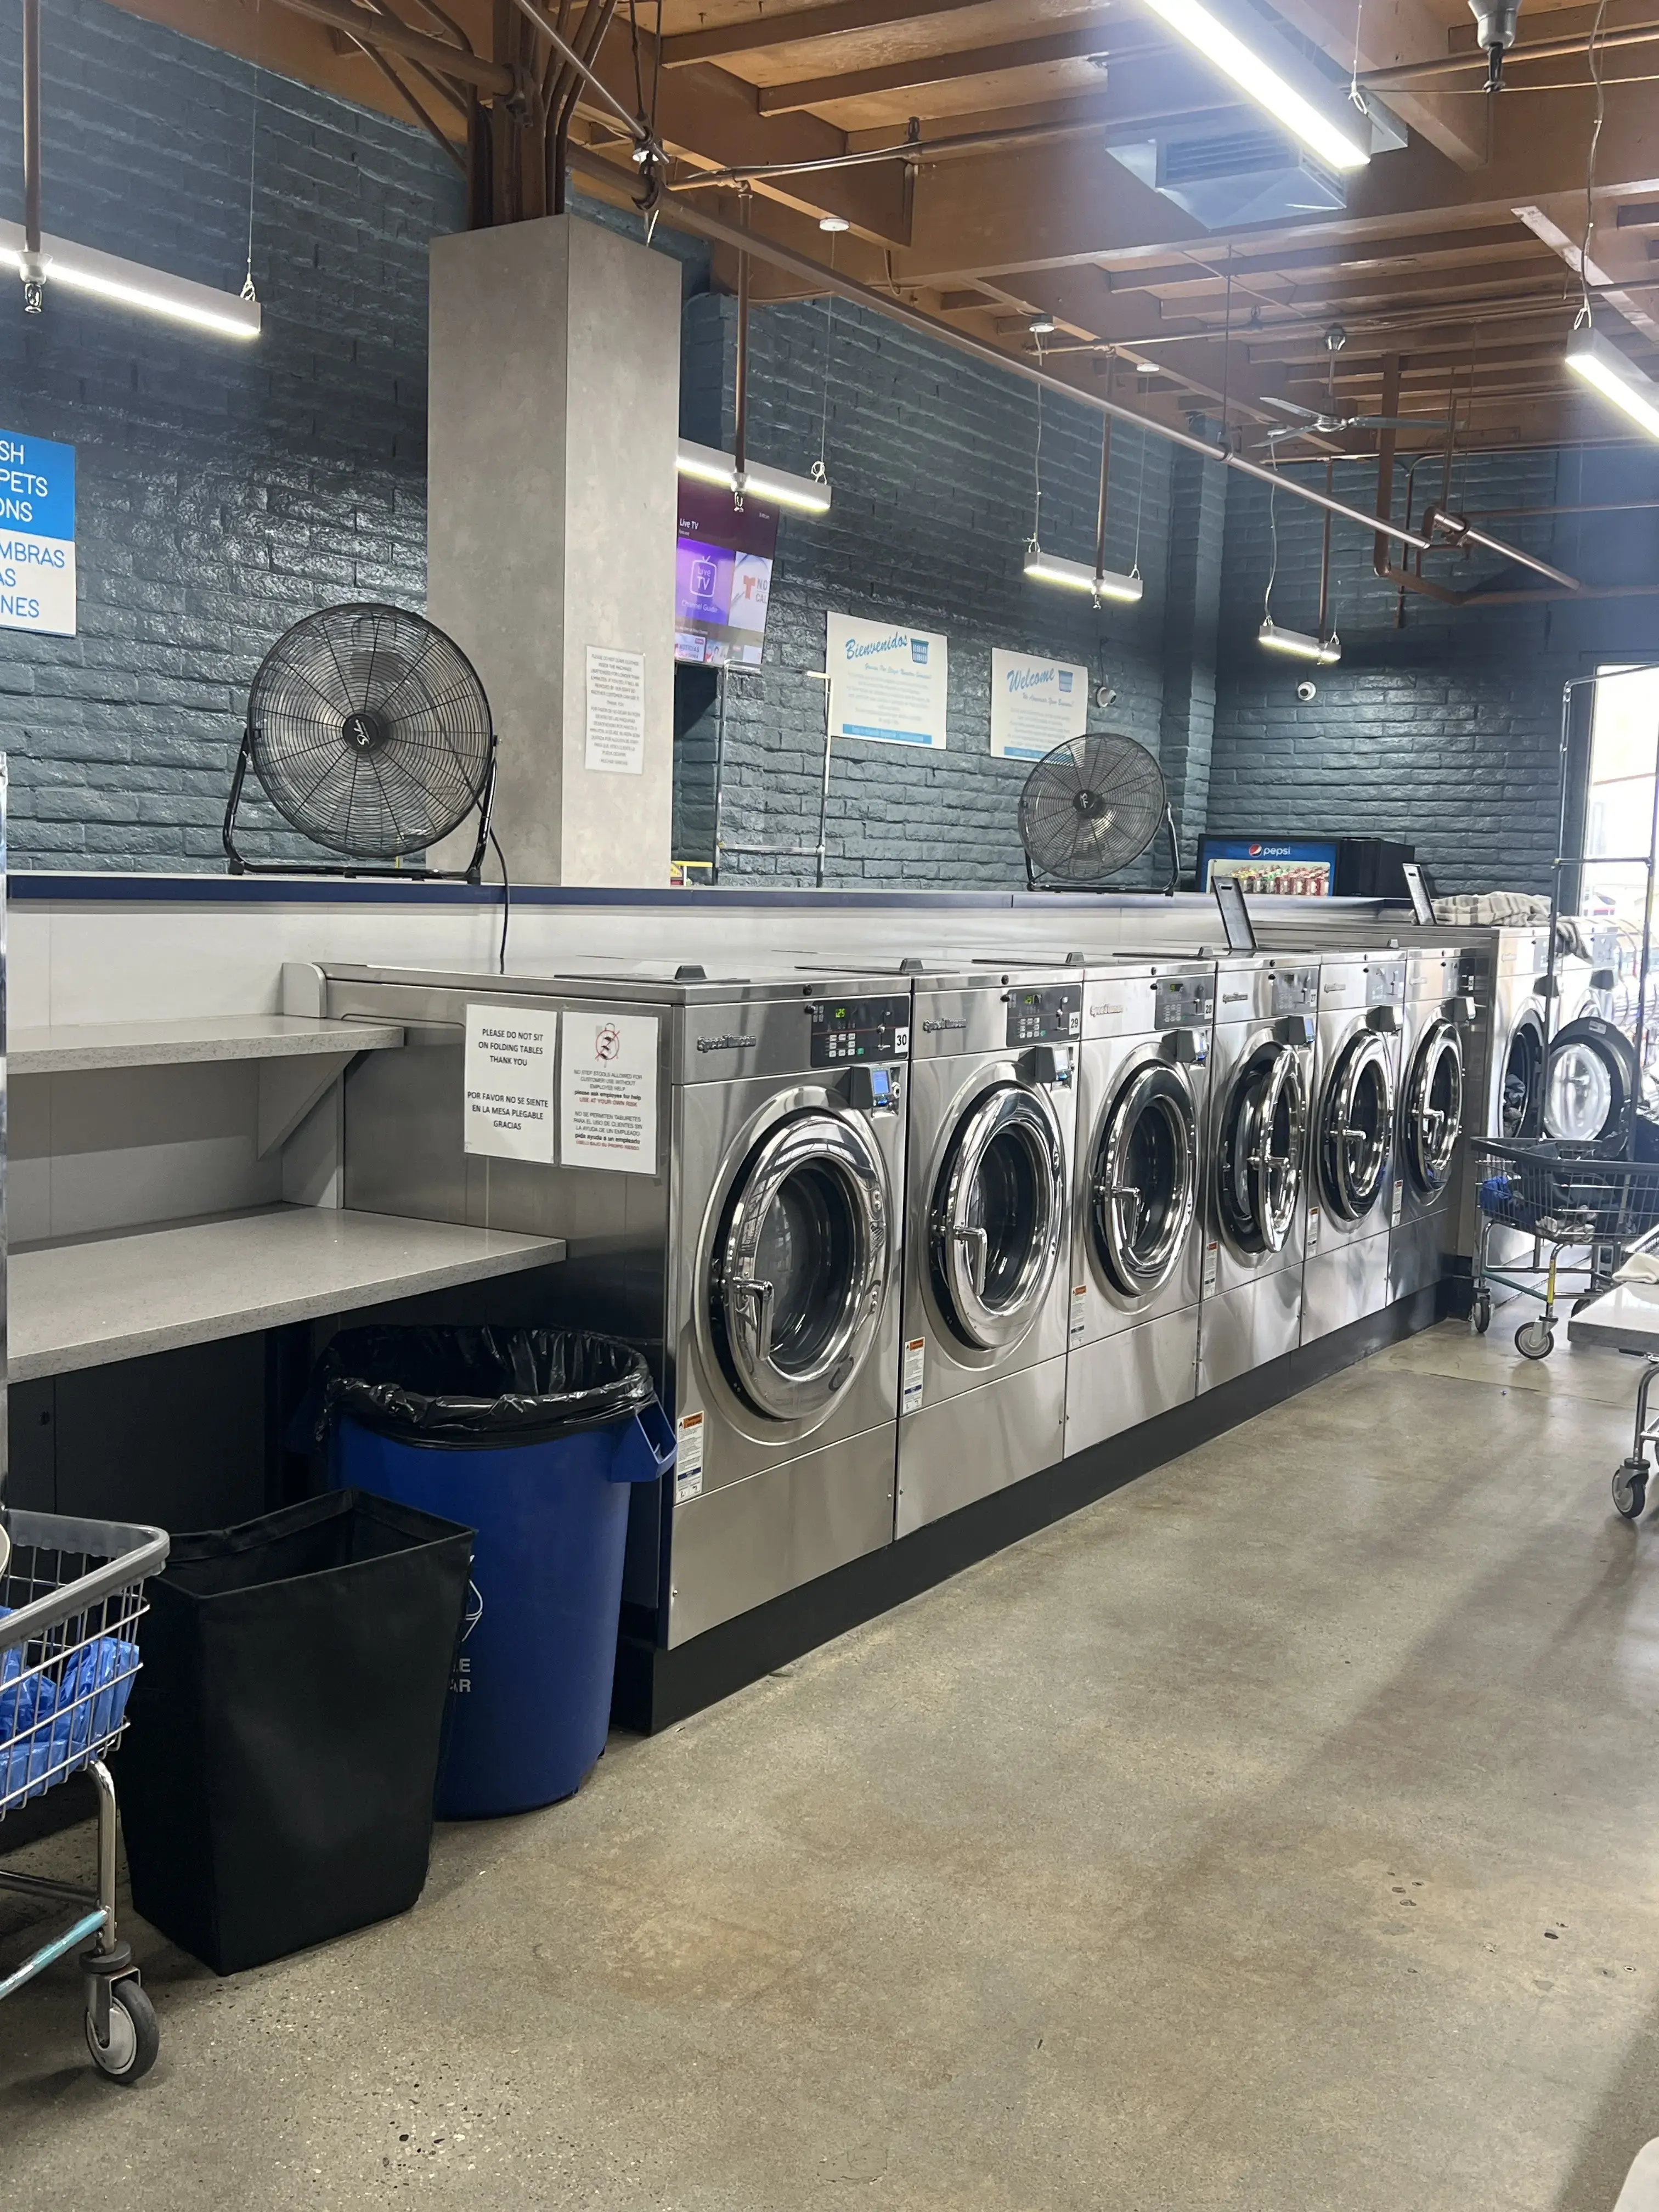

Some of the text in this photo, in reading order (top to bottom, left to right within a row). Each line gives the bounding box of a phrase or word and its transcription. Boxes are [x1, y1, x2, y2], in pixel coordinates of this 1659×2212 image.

[680, 518, 699, 530] Live TV
[698, 566, 711, 577] Live
[697, 577, 710, 590] TV
[1, 595, 39, 618] NES
[845, 631, 909, 659] Bienvenidos
[1007, 667, 1055, 692] Welcome
[1263, 847, 1291, 857] pepsi
[1070, 1017, 1078, 1028] 29
[482, 1029, 505, 1037] PLEASE
[896, 1034, 907, 1046] 30
[490, 1042, 518, 1052] FOLDING
[521, 1046, 543, 1054] TABLES
[490, 1056, 512, 1064] THANK
[467, 1091, 481, 1099] POR
[482, 1093, 504, 1102] FAVOR
[526, 1098, 548, 1108] SIENTE
[492, 1107, 510, 1116] MESA
[512, 1109, 543, 1120] PLEGABLE
[494, 1120, 521, 1130] GRACIAS
